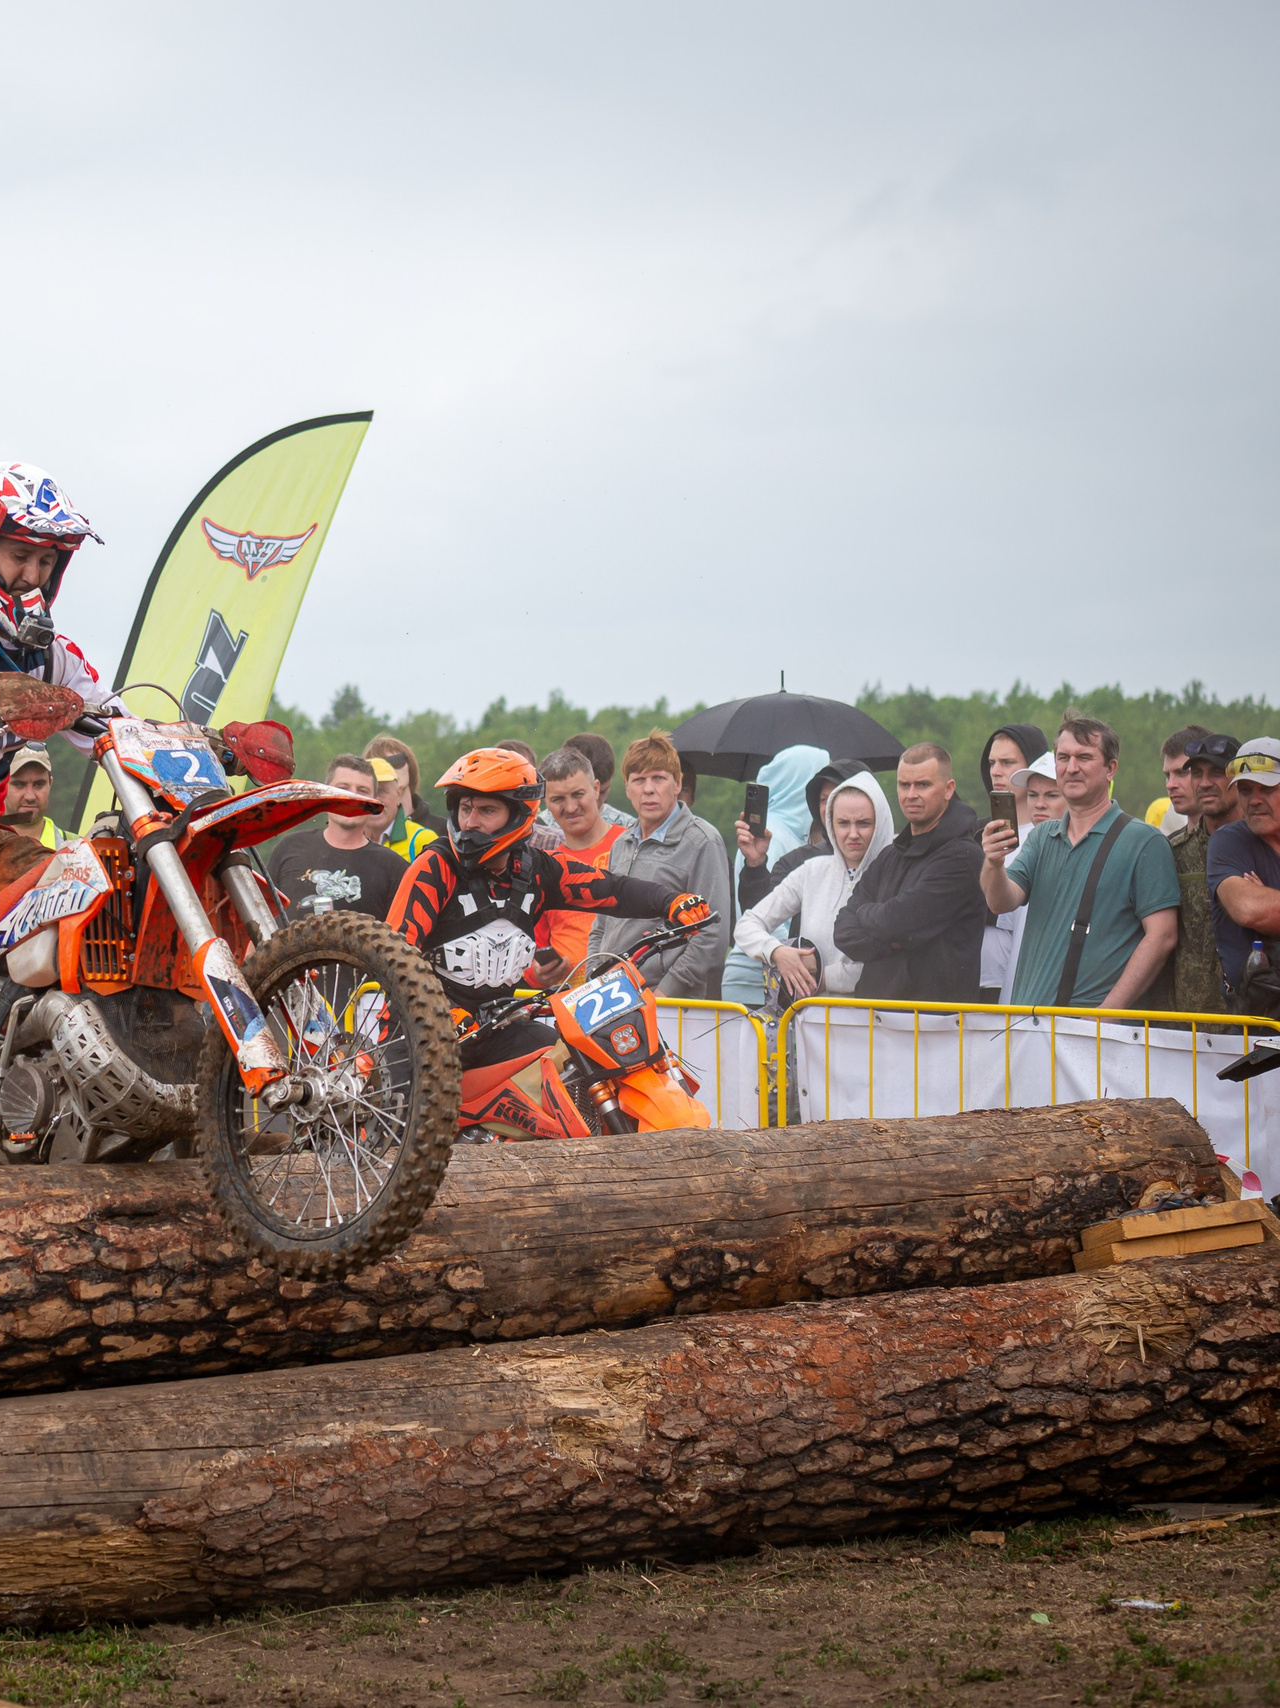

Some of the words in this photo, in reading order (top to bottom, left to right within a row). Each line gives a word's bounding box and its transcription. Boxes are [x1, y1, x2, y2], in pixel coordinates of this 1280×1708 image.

[169, 750, 211, 784] 2
[679, 893, 705, 911] FOX
[577, 980, 633, 1026] 23
[492, 1100, 538, 1133] KTM
